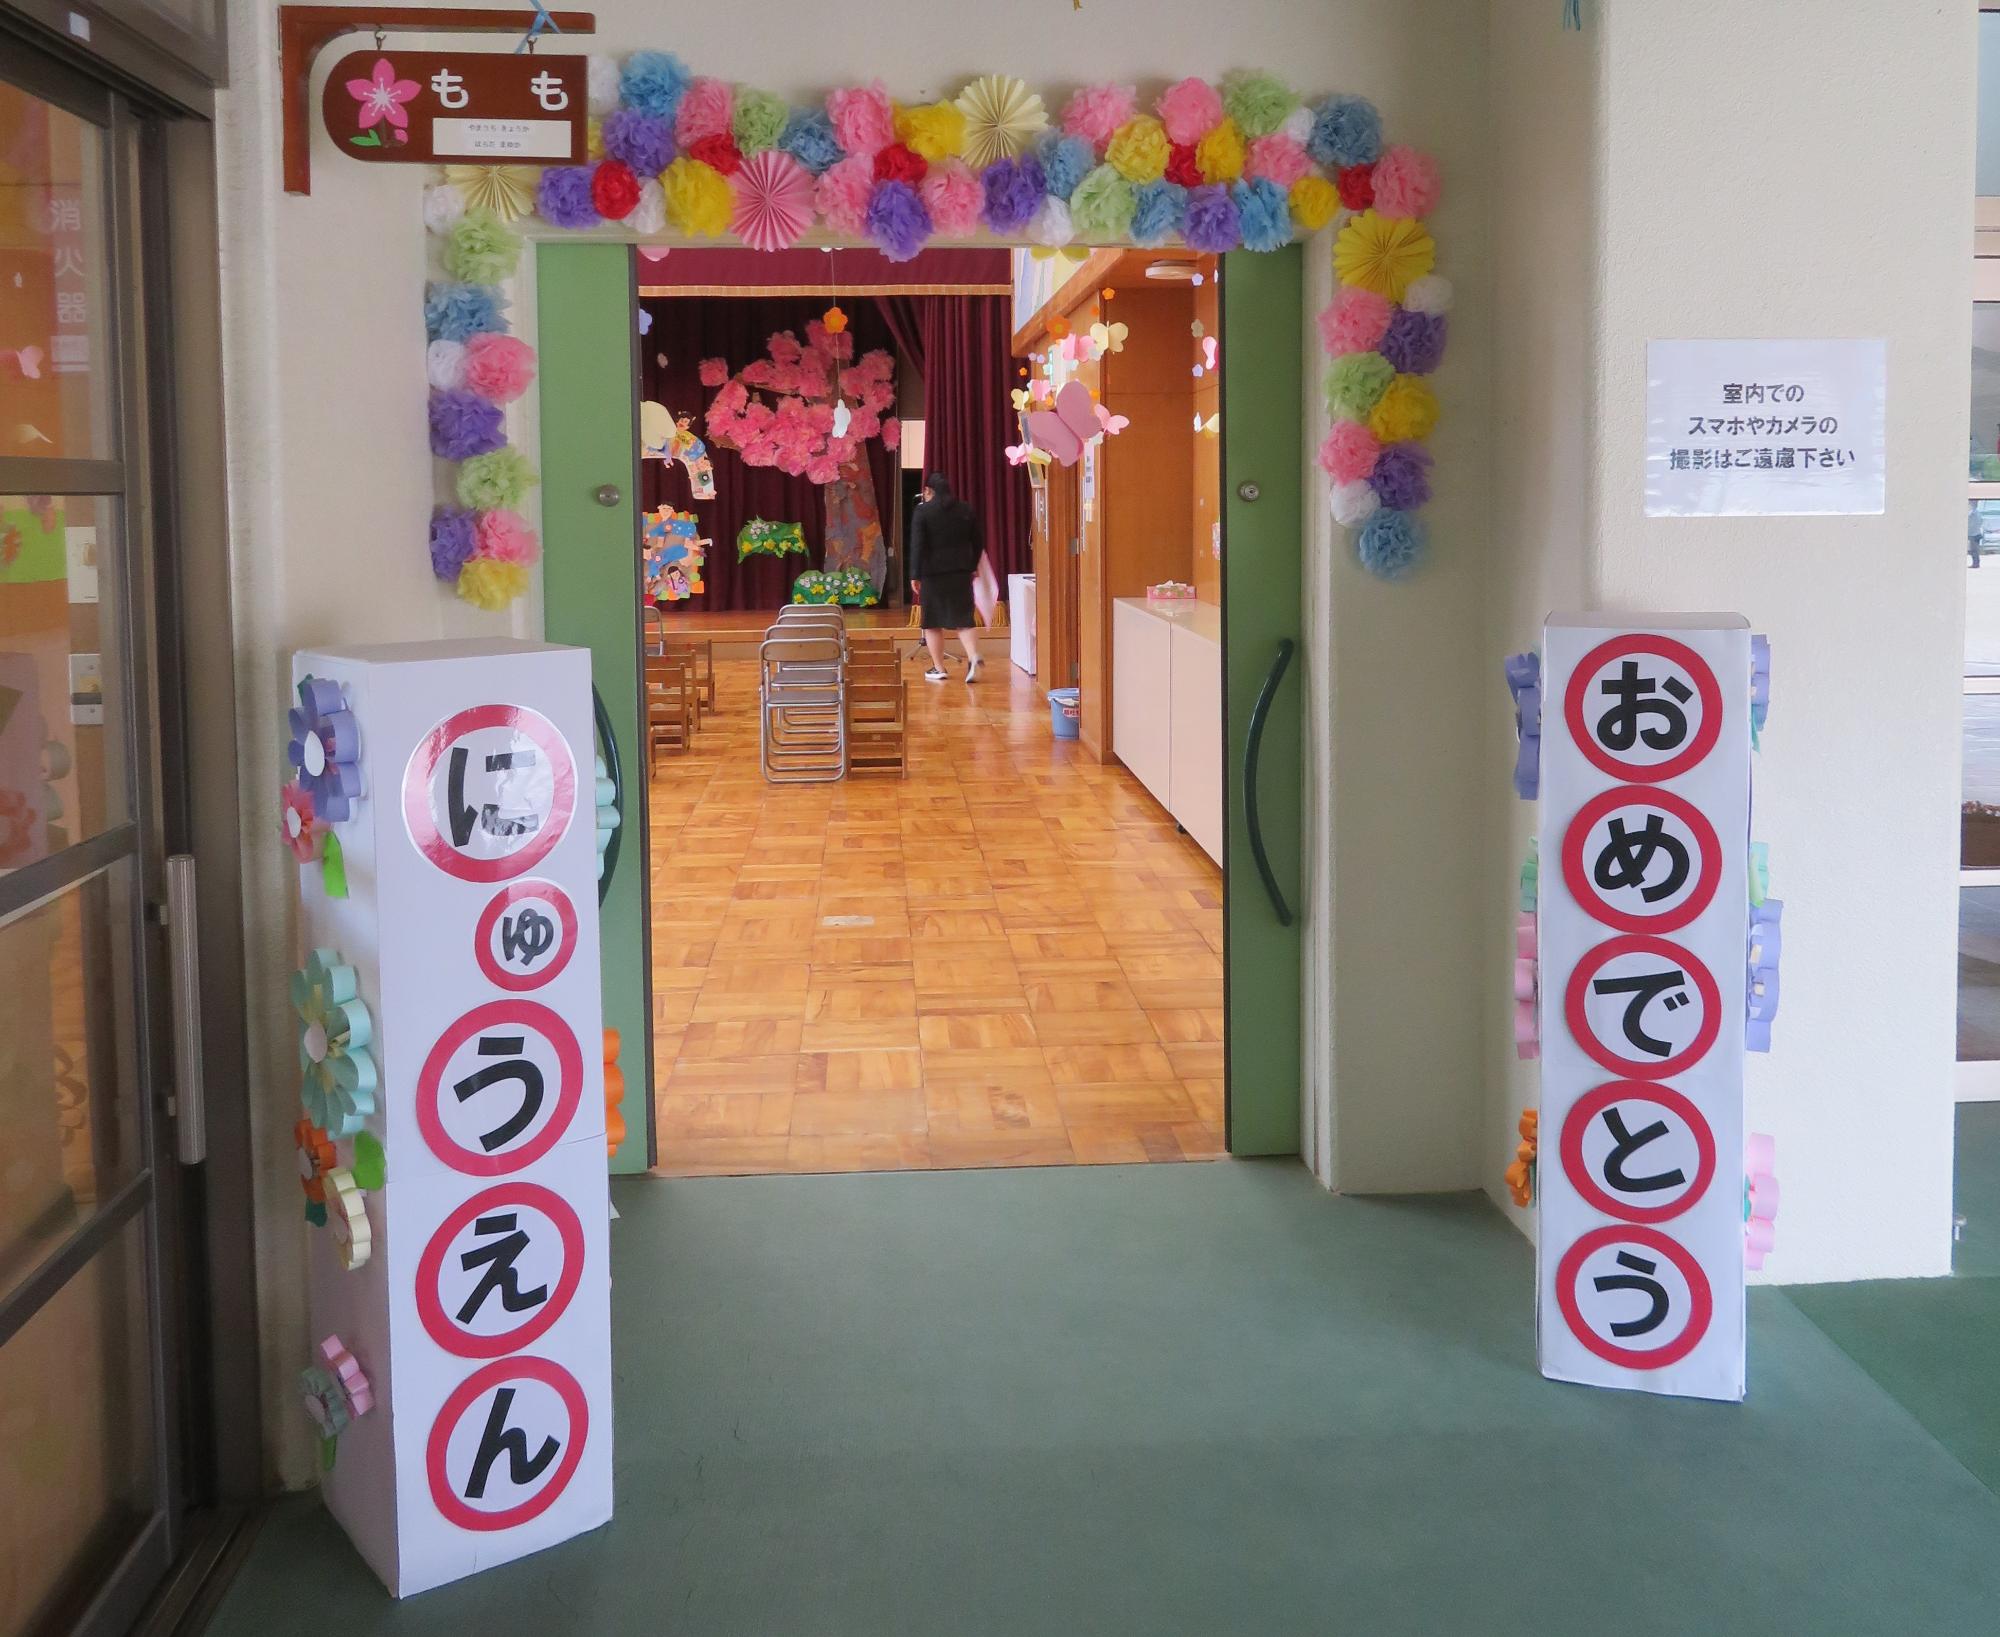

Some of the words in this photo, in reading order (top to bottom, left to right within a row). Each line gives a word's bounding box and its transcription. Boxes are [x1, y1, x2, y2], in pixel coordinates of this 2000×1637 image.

[50, 199, 86, 324] 消火器
[1688, 415, 1839, 436] スマホやカメラの
[1722, 383, 1805, 404] 室内での
[1669, 447, 1856, 470] 撮影はご遠慮下さい
[1593, 661, 1693, 1338] おめでとう
[447, 746, 561, 1499] にゅうえん
